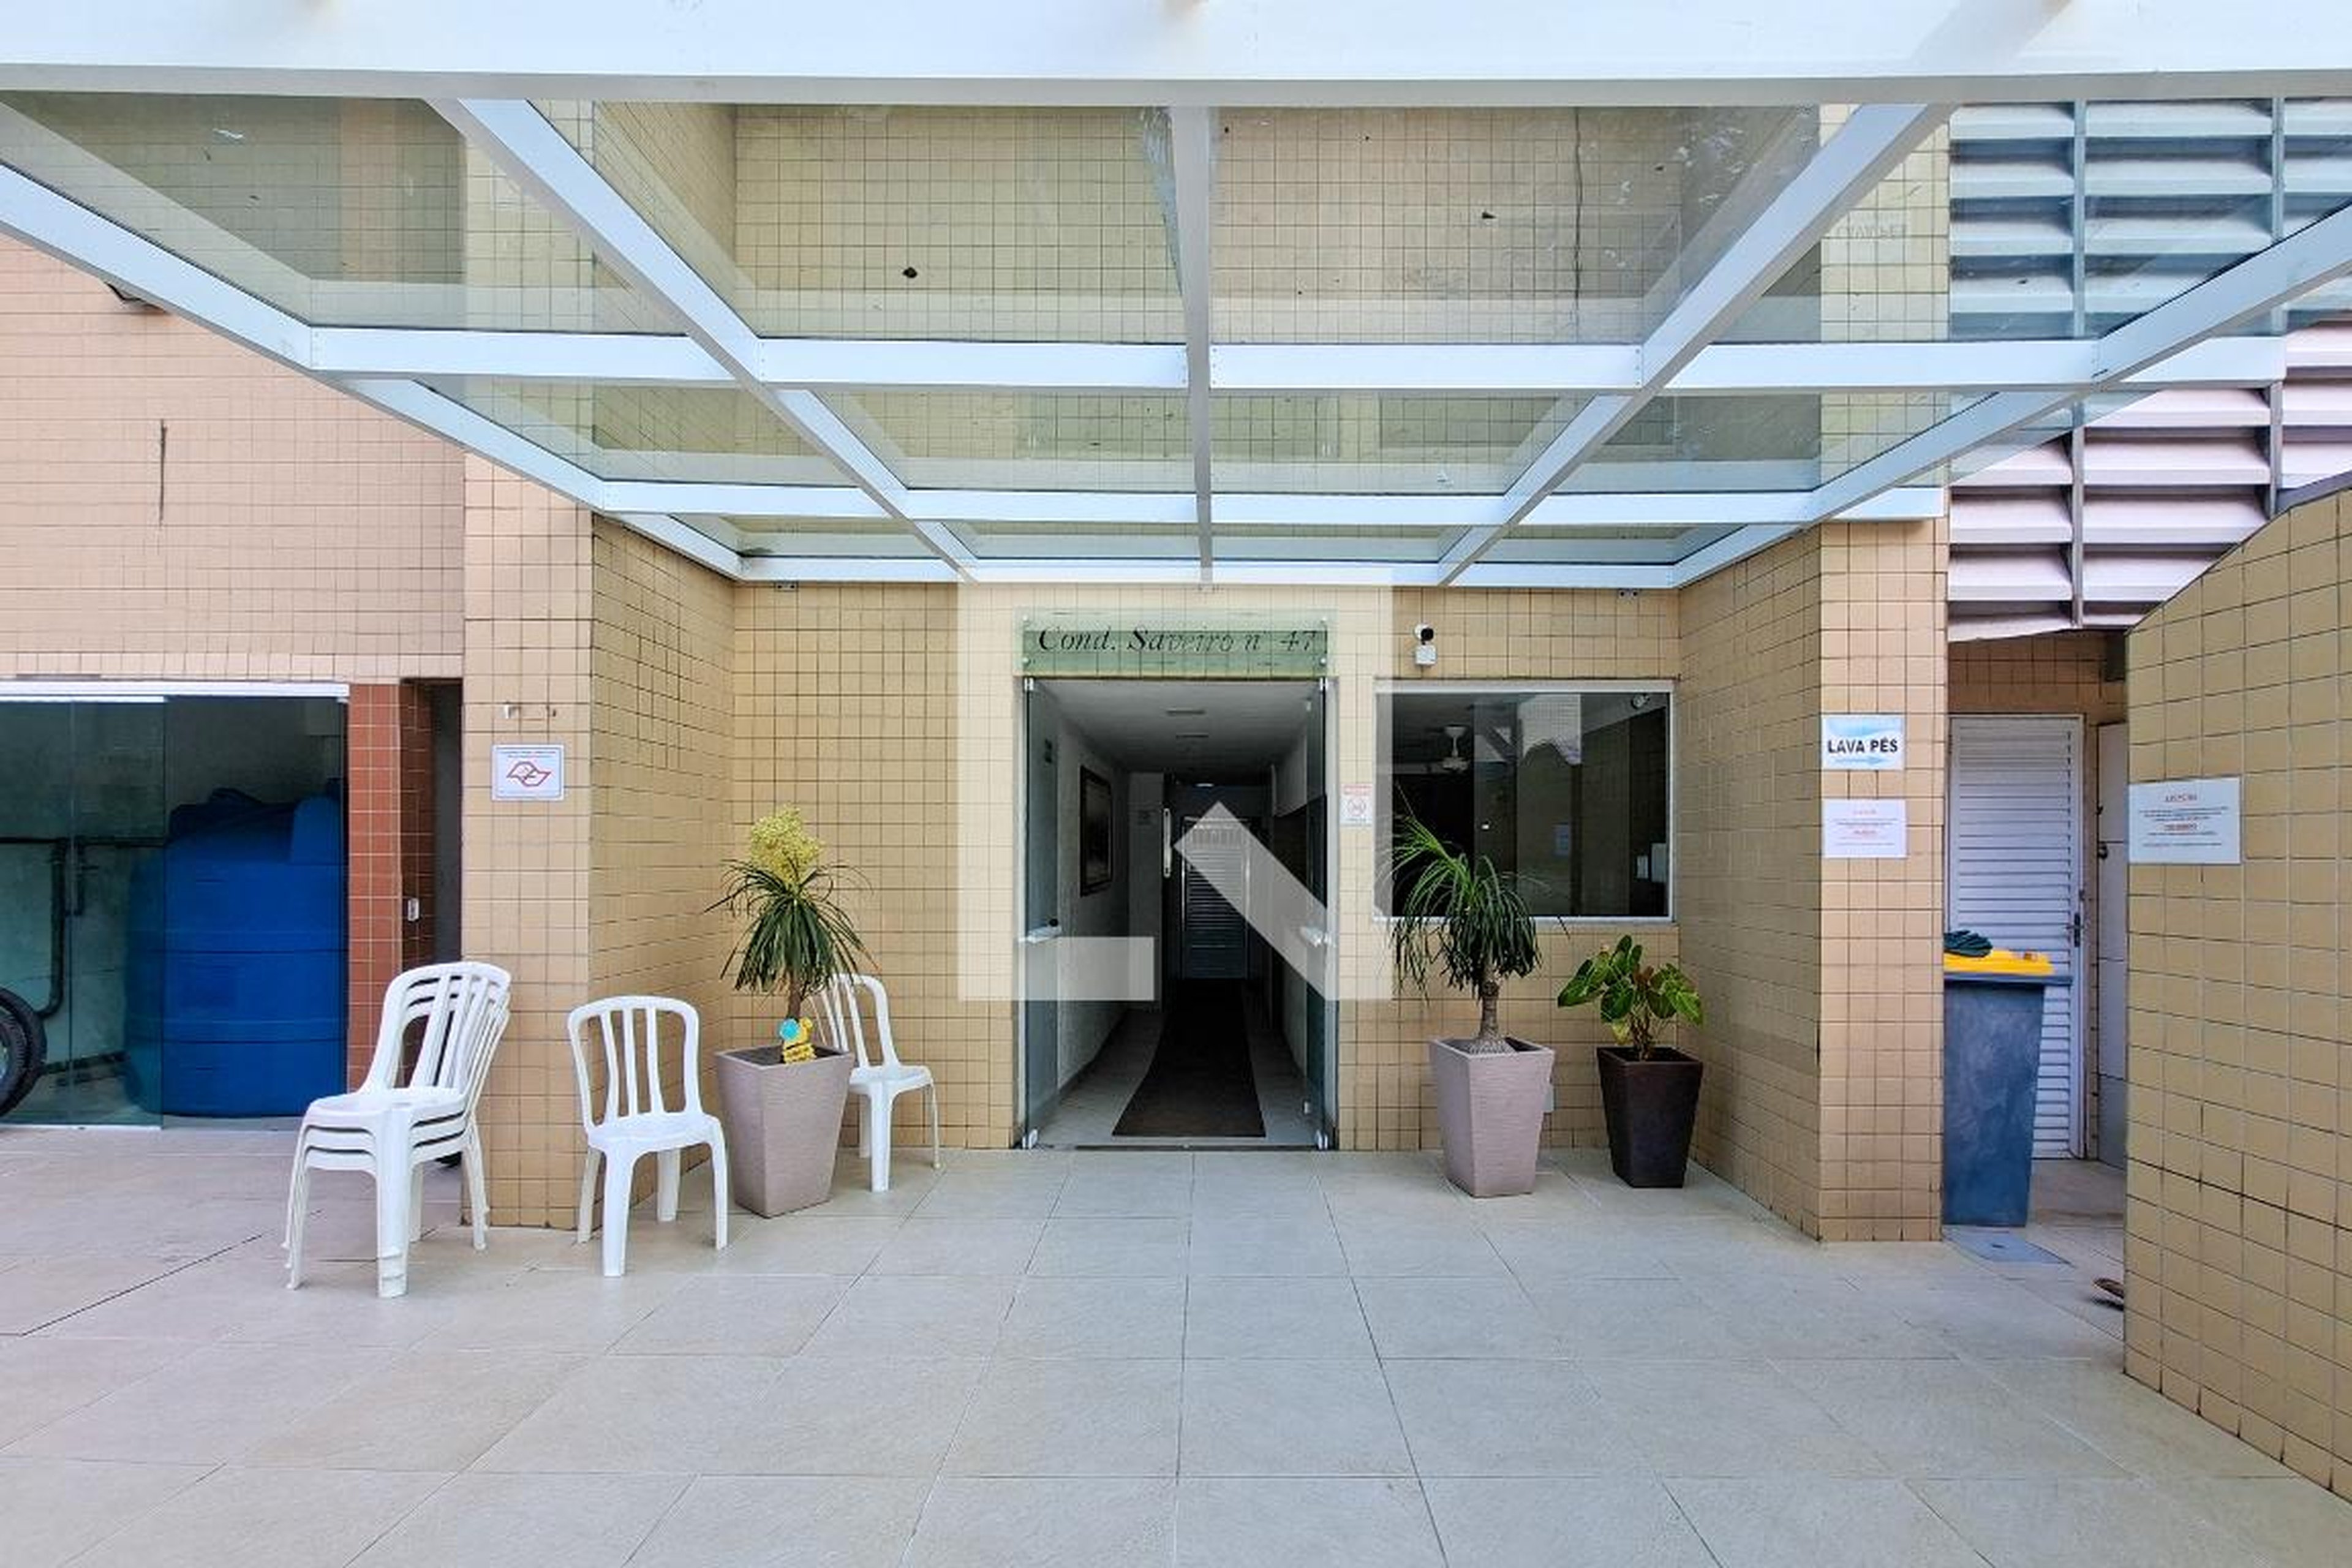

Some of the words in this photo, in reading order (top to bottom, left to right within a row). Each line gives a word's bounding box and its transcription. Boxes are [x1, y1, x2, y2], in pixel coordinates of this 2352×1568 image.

[1039, 625, 1115, 651] Cond.
[1280, 630, 1317, 651] 47
[1828, 739, 1865, 753] LAVA
